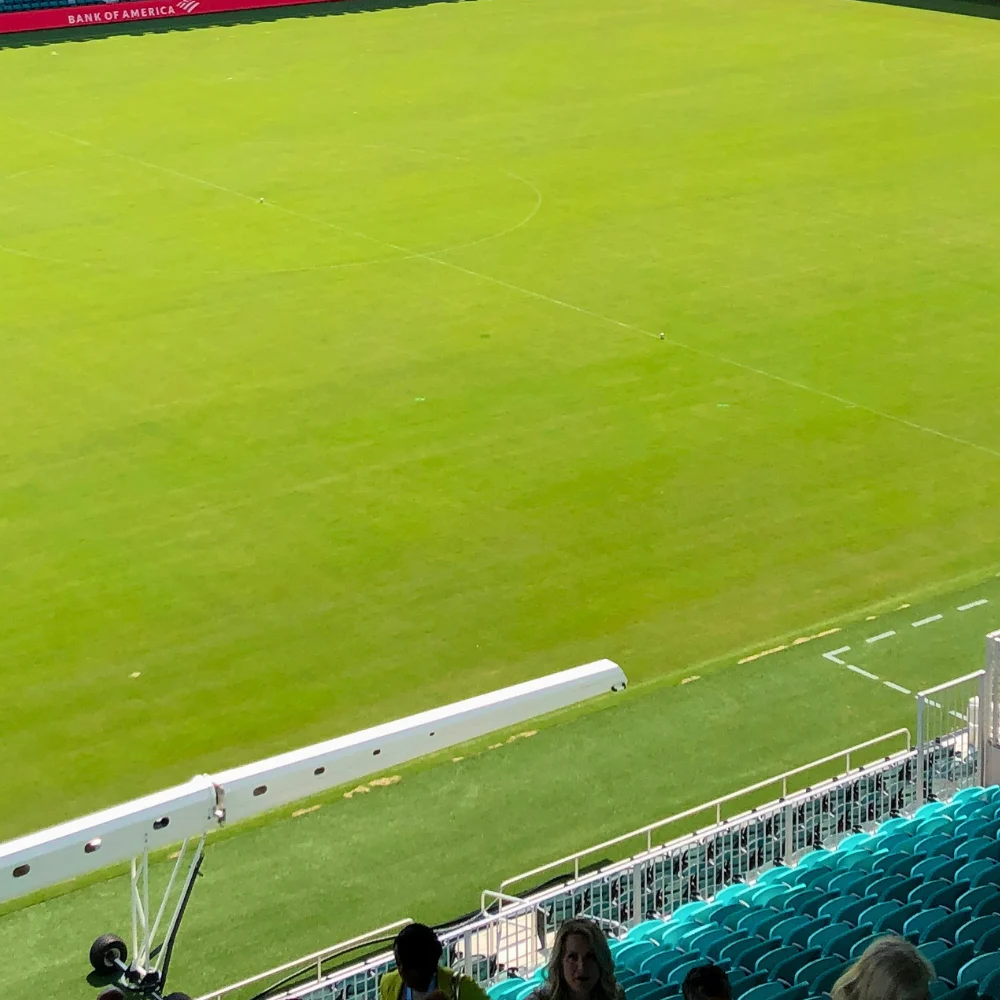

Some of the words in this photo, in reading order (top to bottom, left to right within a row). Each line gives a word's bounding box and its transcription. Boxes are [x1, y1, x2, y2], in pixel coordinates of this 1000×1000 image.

[67, 12, 102, 24] BANK
[104, 10, 119, 20] OF
[122, 5, 176, 19] AMERICA
